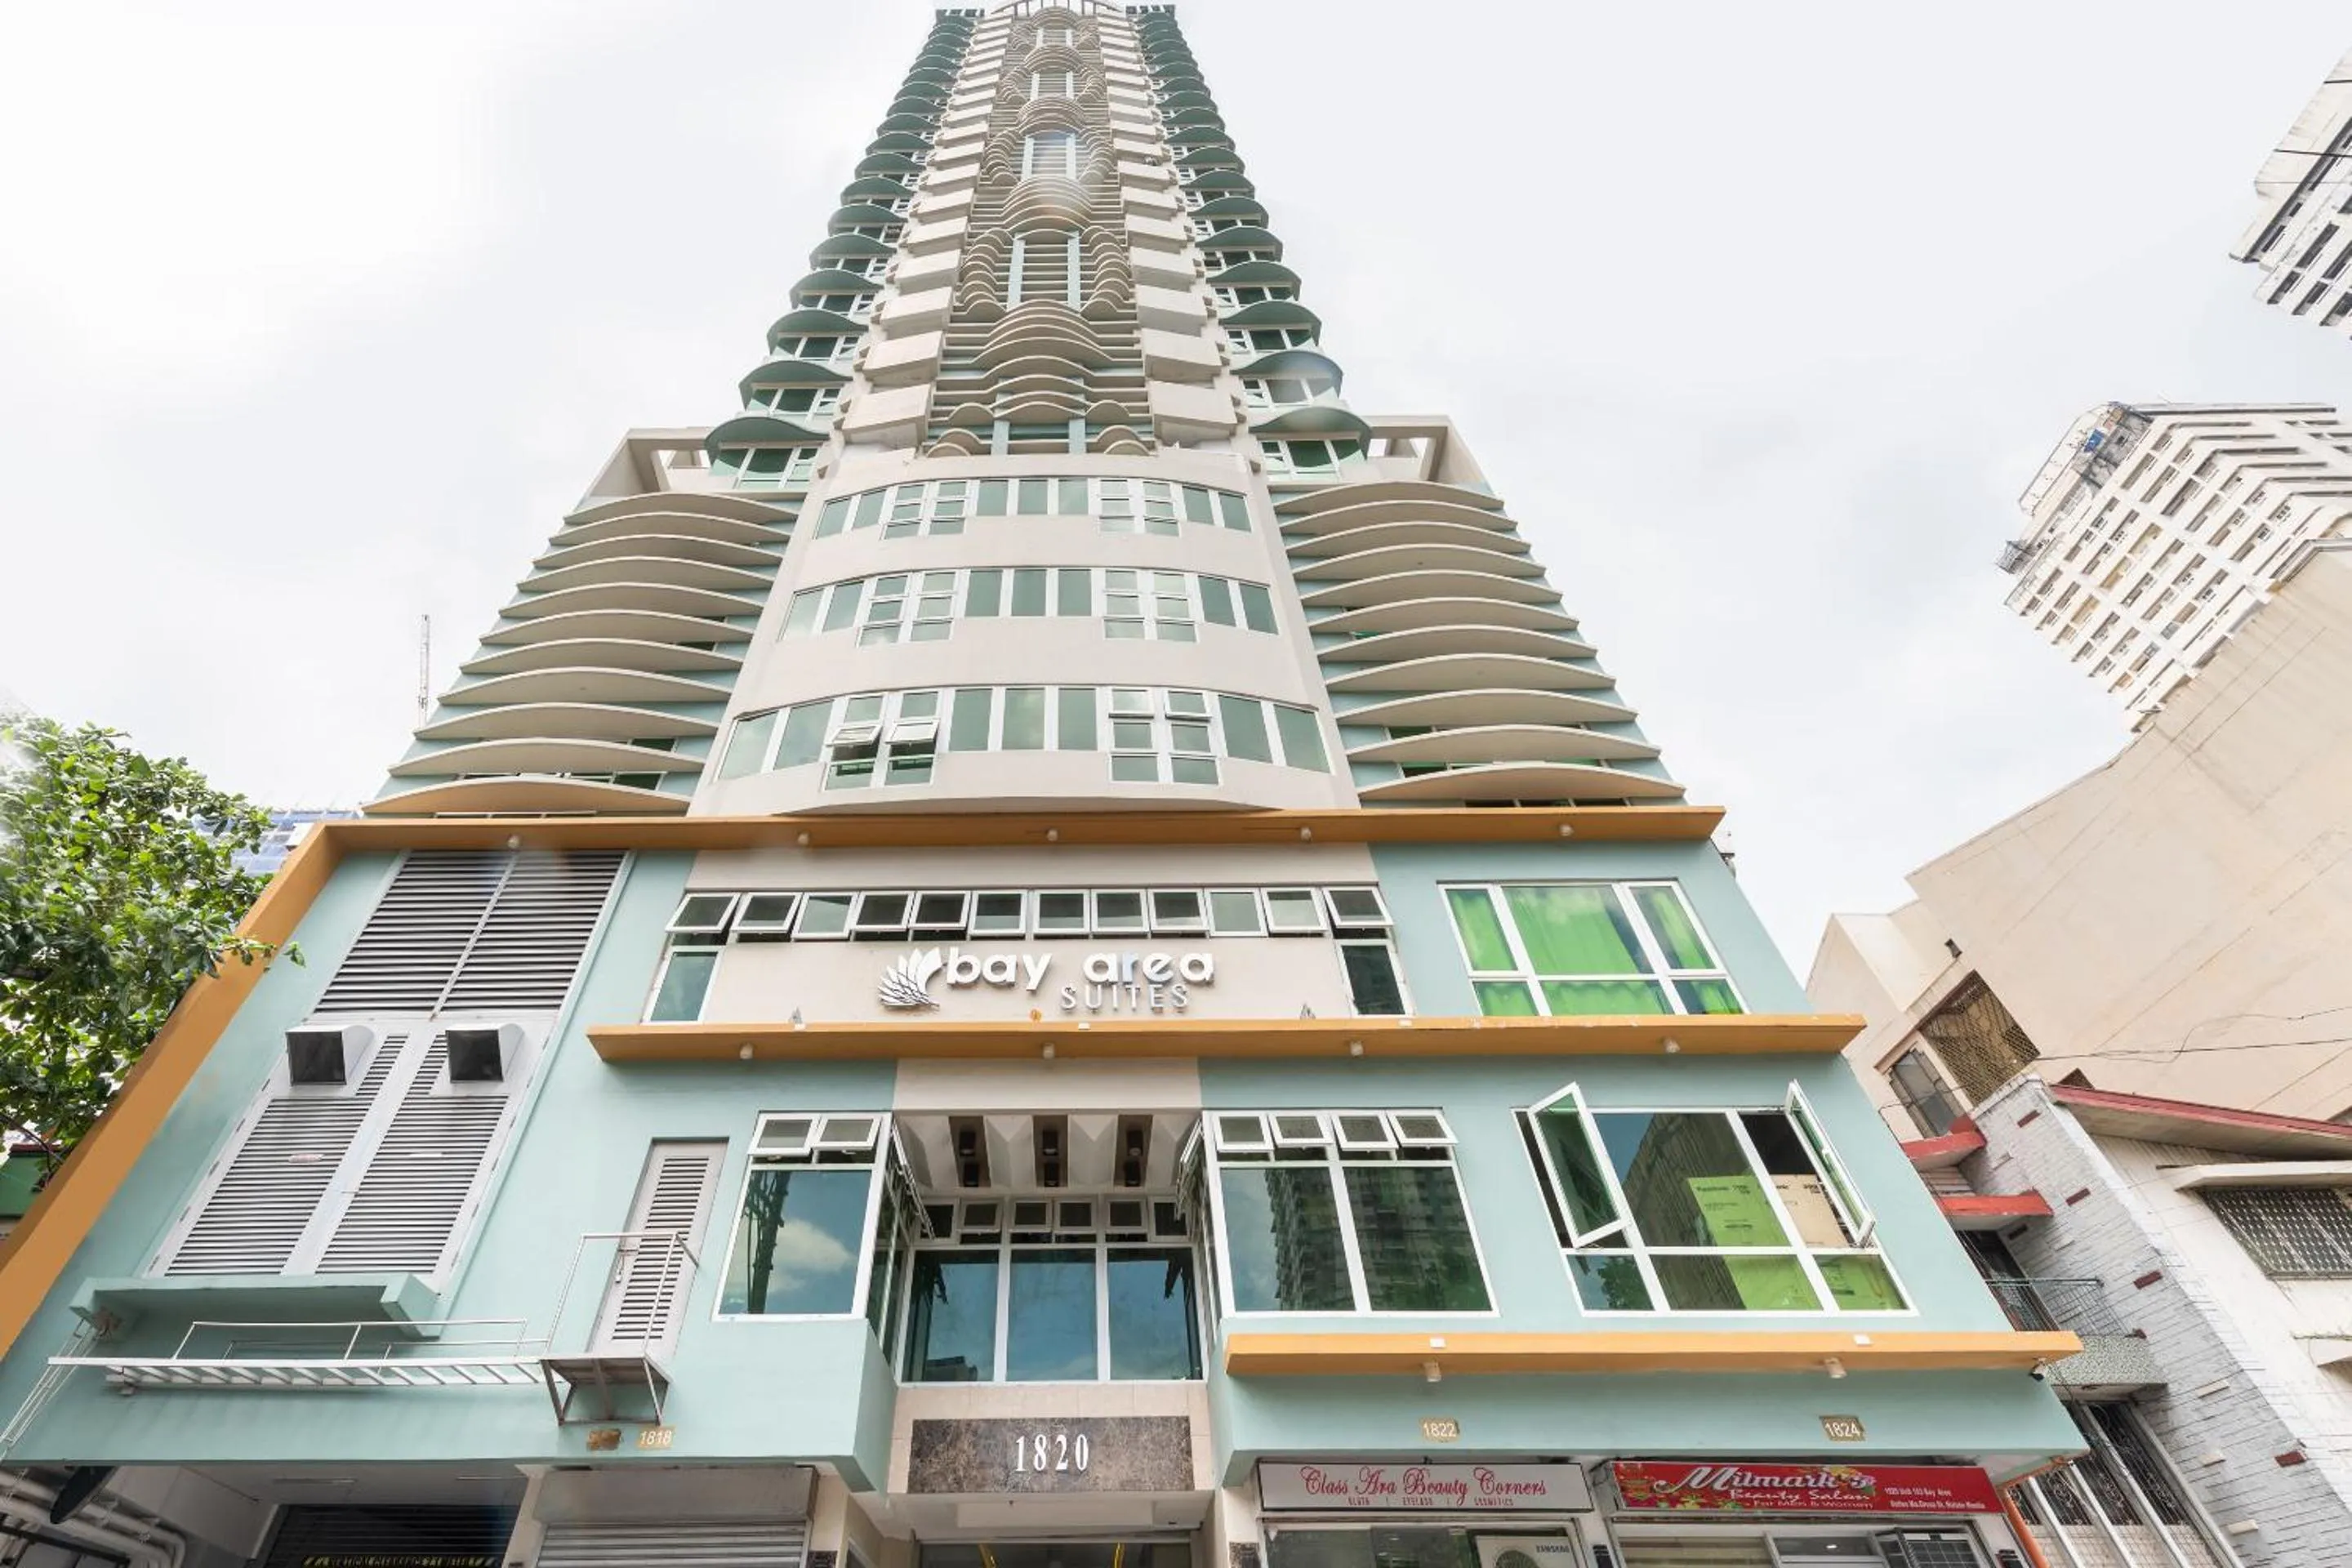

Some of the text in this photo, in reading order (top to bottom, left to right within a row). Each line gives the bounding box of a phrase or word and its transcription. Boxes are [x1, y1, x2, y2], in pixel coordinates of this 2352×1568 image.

[947, 947, 1214, 991] bay area
[1061, 984, 1187, 1011] SUITES
[639, 1430, 673, 1446] 1818
[1423, 1422, 1457, 1437] 1822
[1825, 1421, 1860, 1437] 1824
[1015, 1433, 1089, 1472] 1820
[1300, 1466, 1348, 1495] Class
[1403, 1467, 1468, 1507] Beauty
[1473, 1467, 1547, 1495] Corners
[1730, 1489, 1870, 1503] Beauty Salon
